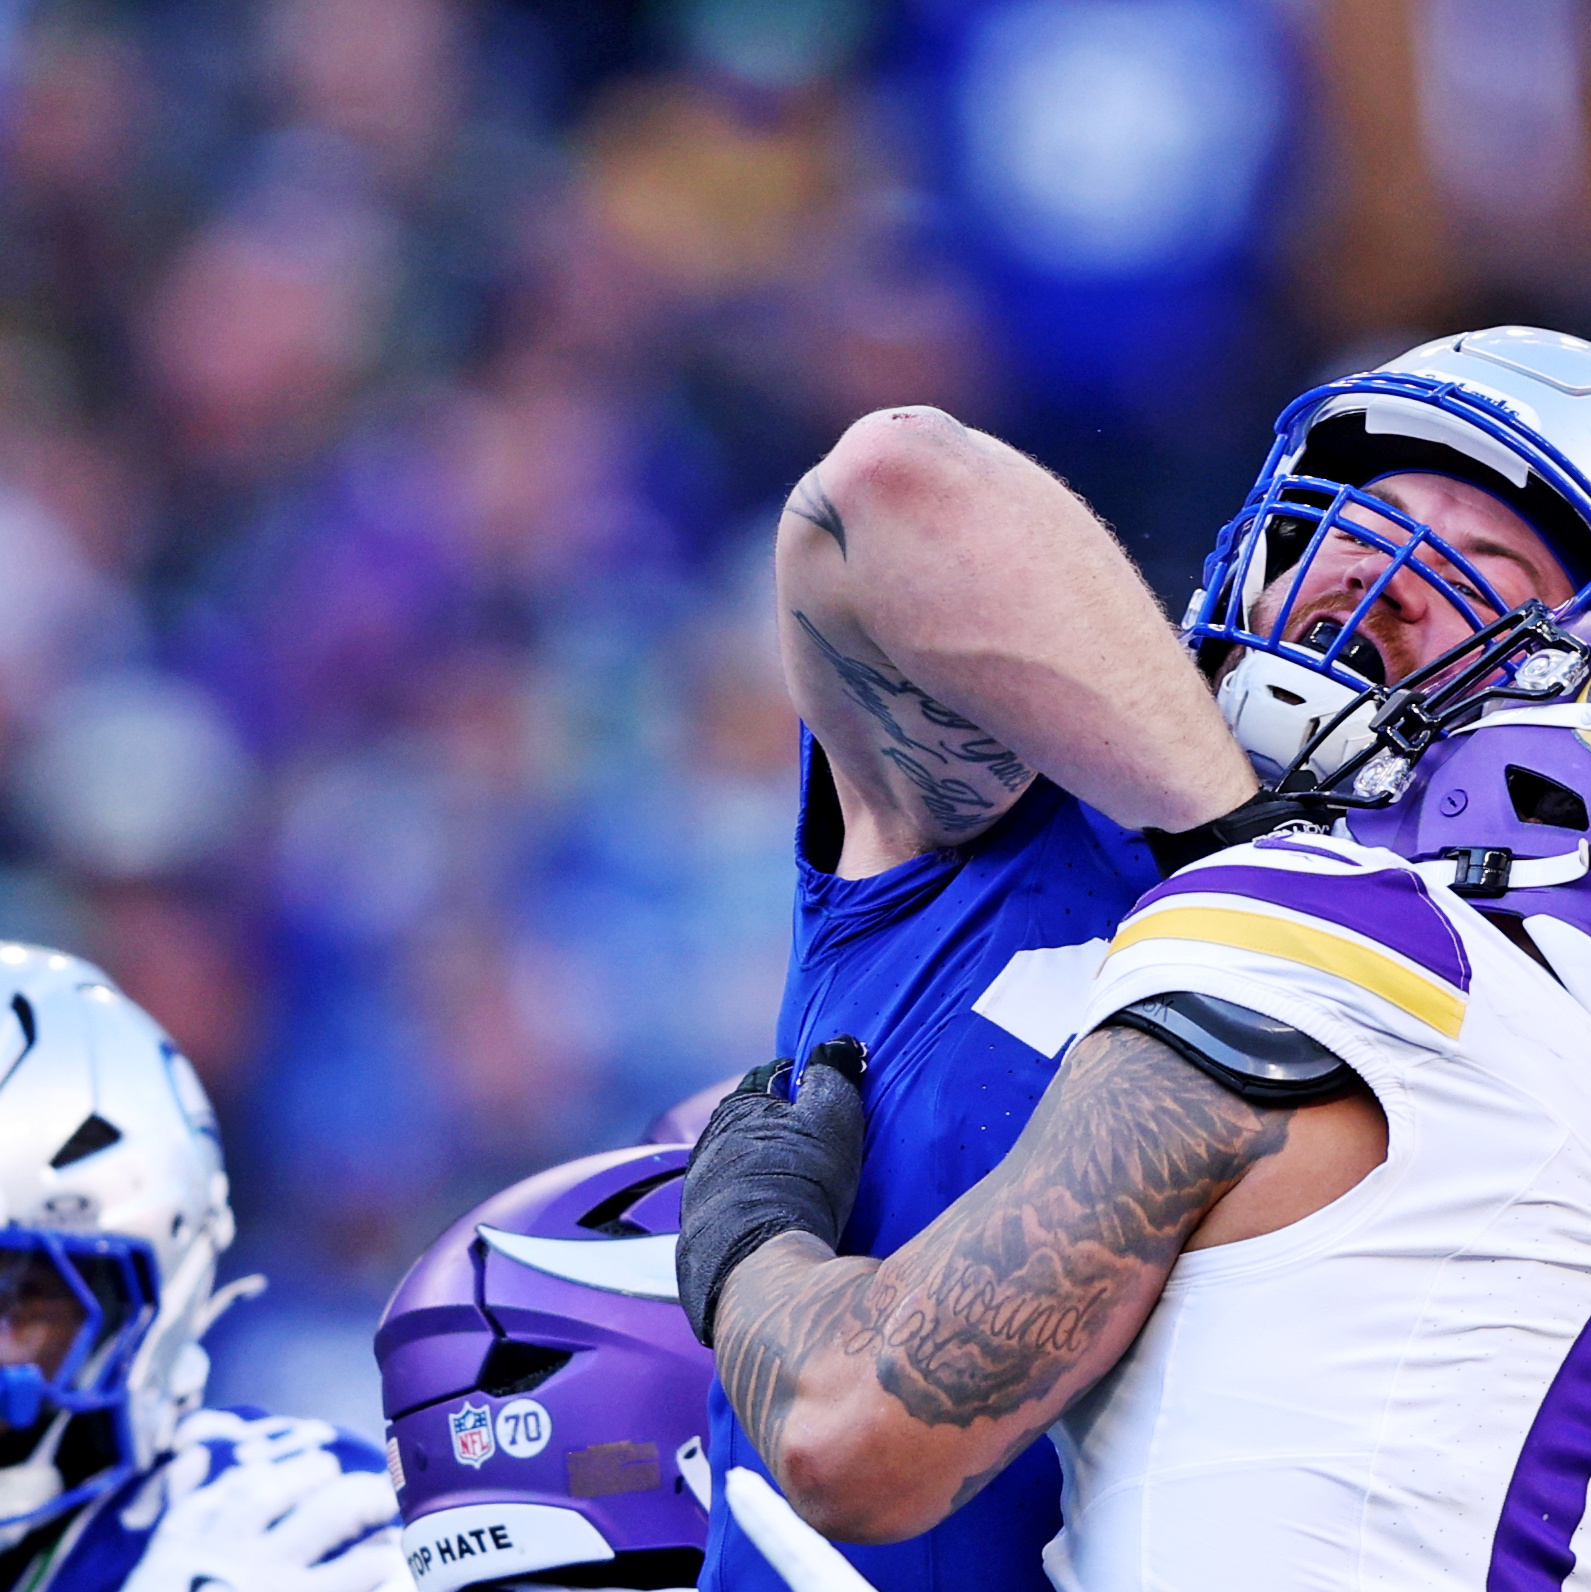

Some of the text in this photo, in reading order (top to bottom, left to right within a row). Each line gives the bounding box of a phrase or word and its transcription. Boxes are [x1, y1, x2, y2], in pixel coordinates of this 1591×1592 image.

[458, 1429, 491, 1457] NFL
[503, 1410, 542, 1446] 70
[408, 1524, 514, 1584] TOP HATE
